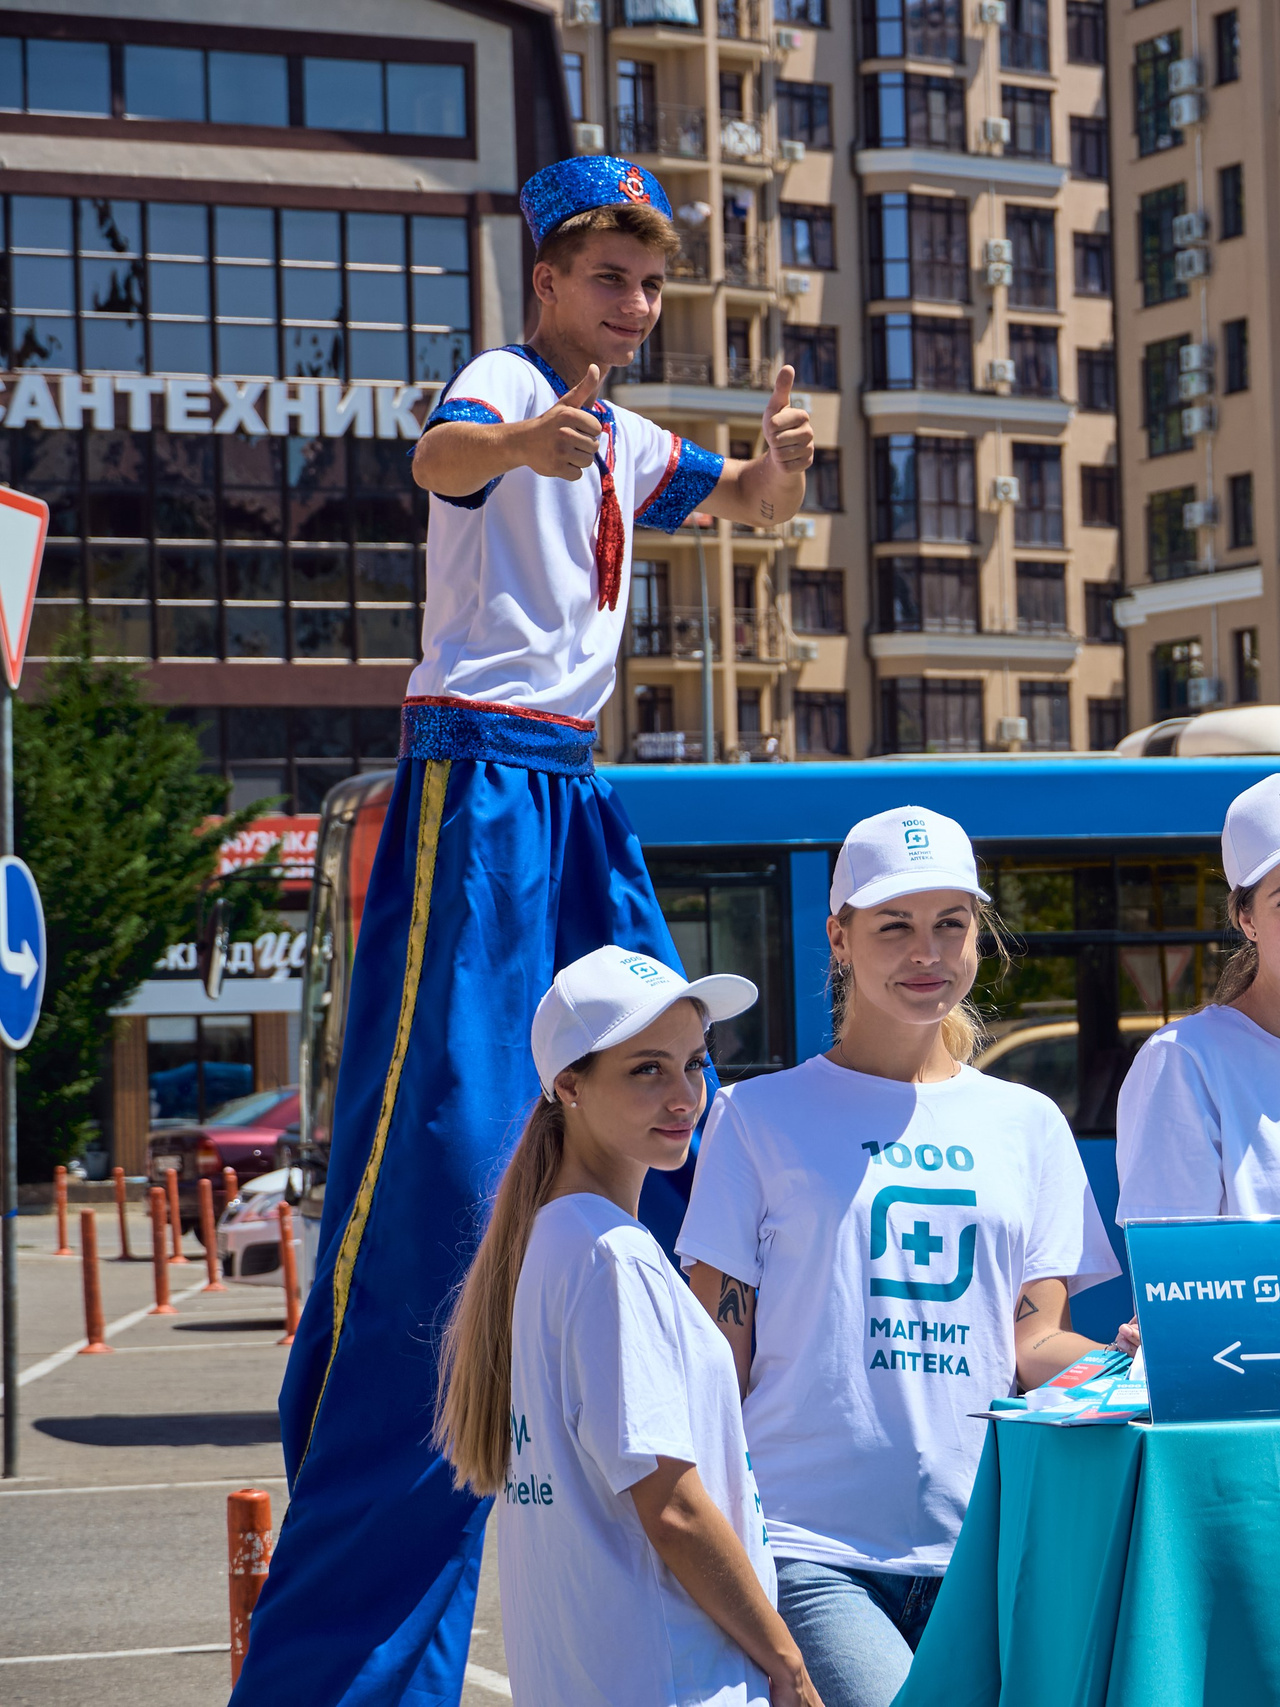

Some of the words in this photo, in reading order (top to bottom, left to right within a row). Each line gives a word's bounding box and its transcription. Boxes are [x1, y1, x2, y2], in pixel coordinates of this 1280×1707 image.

[0, 373, 444, 440] АНТЕХНИК
[902, 819, 925, 828] 1000
[861, 1141, 974, 1172] 1000
[1145, 1280, 1246, 1302] МАГНИТ
[870, 1317, 970, 1345] МАГНИТ
[870, 1349, 971, 1377] АПТЕКА
